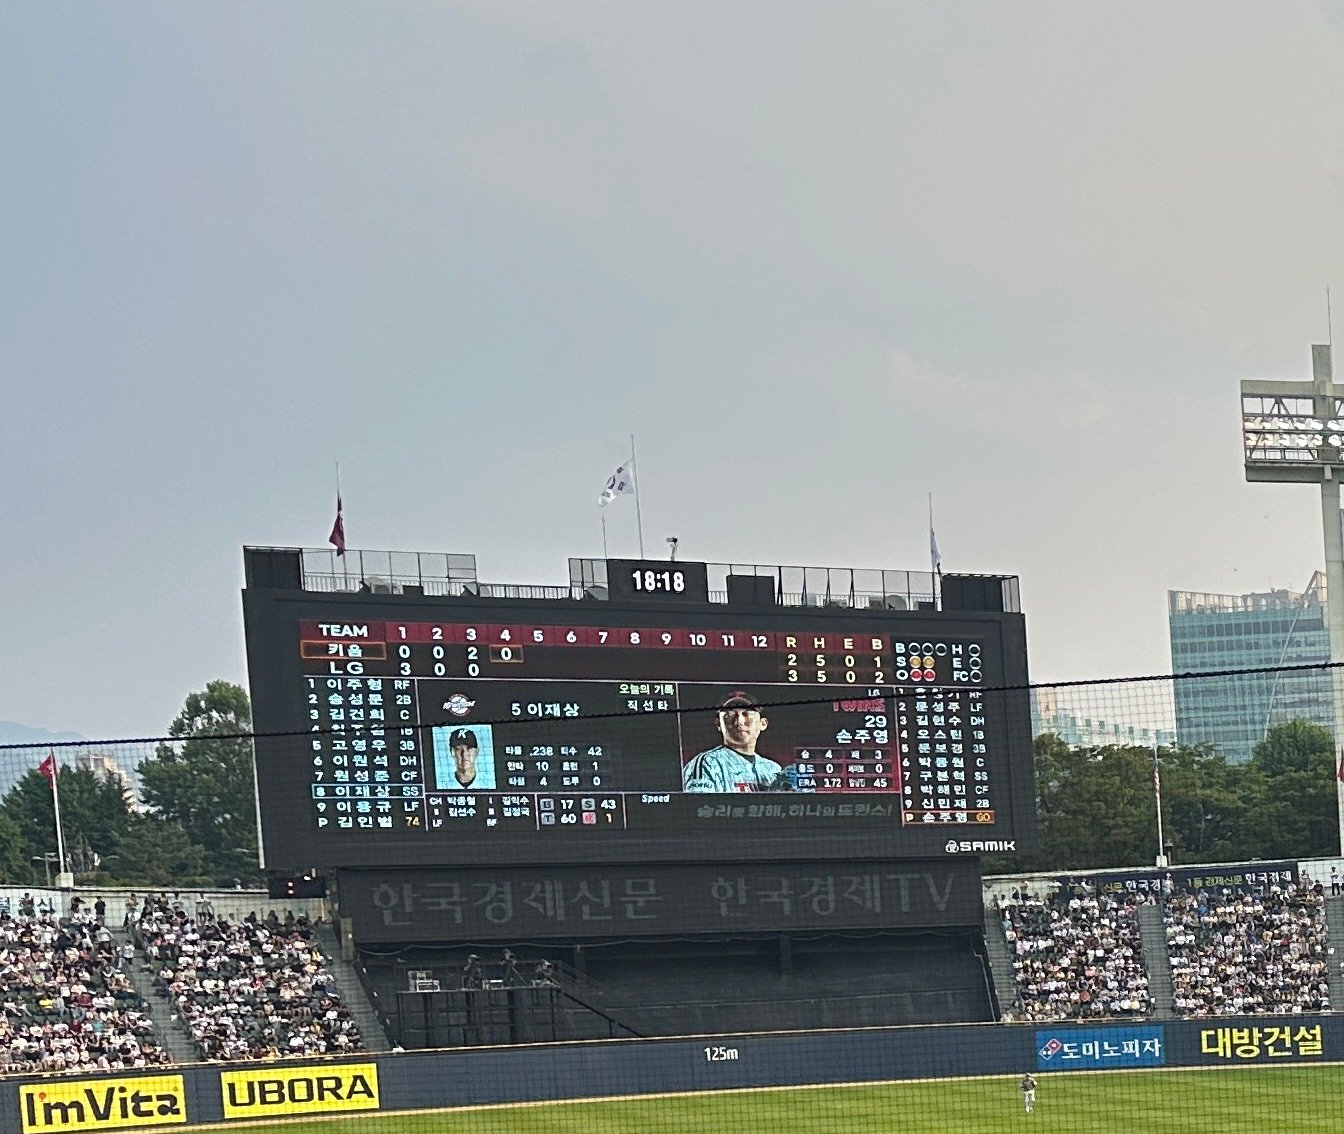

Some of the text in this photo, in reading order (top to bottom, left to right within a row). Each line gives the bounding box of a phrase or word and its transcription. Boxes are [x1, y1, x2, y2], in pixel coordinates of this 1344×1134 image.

[632, 570, 685, 592] 18:18
[318, 623, 882, 650] TEAM 1 2 3 4 5 6 7 8 9 10 11 12 R H E B
[895, 642, 962, 655] B H
[328, 643, 881, 668] 키움 0 0 2 0 2 5 0 1
[896, 656, 962, 668] S E
[329, 661, 884, 684] LG 3 0 0 3 5 0 2
[953, 671, 969, 682] FC
[308, 679, 315, 688] 1
[394, 680, 410, 690] RF
[618, 684, 675, 695] 오늘의 기록
[511, 702, 580, 717] 5 이재상
[899, 702, 983, 712] 2 LF
[309, 709, 319, 720] 3
[400, 710, 410, 720] C
[865, 715, 887, 728] 29
[836, 729, 889, 744] 손주영
[900, 729, 908, 739] 4
[313, 756, 323, 766] 6
[400, 756, 417, 766] DH
[903, 771, 988, 781] 7 SS
[641, 794, 670, 803] Speed
[905, 799, 912, 809] 9
[976, 799, 990, 808] 2B
[317, 802, 326, 813] 9
[404, 801, 419, 812] LF
[318, 818, 328, 828] P
[405, 816, 420, 826] 74
[959, 840, 1016, 852] SAMIK
[372, 871, 956, 927] 한국경제신문 한국경제TV
[1201, 1024, 1323, 1058] 대방건설
[704, 1046, 739, 1062] 125m
[1061, 1037, 1162, 1061] 도미노피자
[226, 1074, 375, 1108] UBORA
